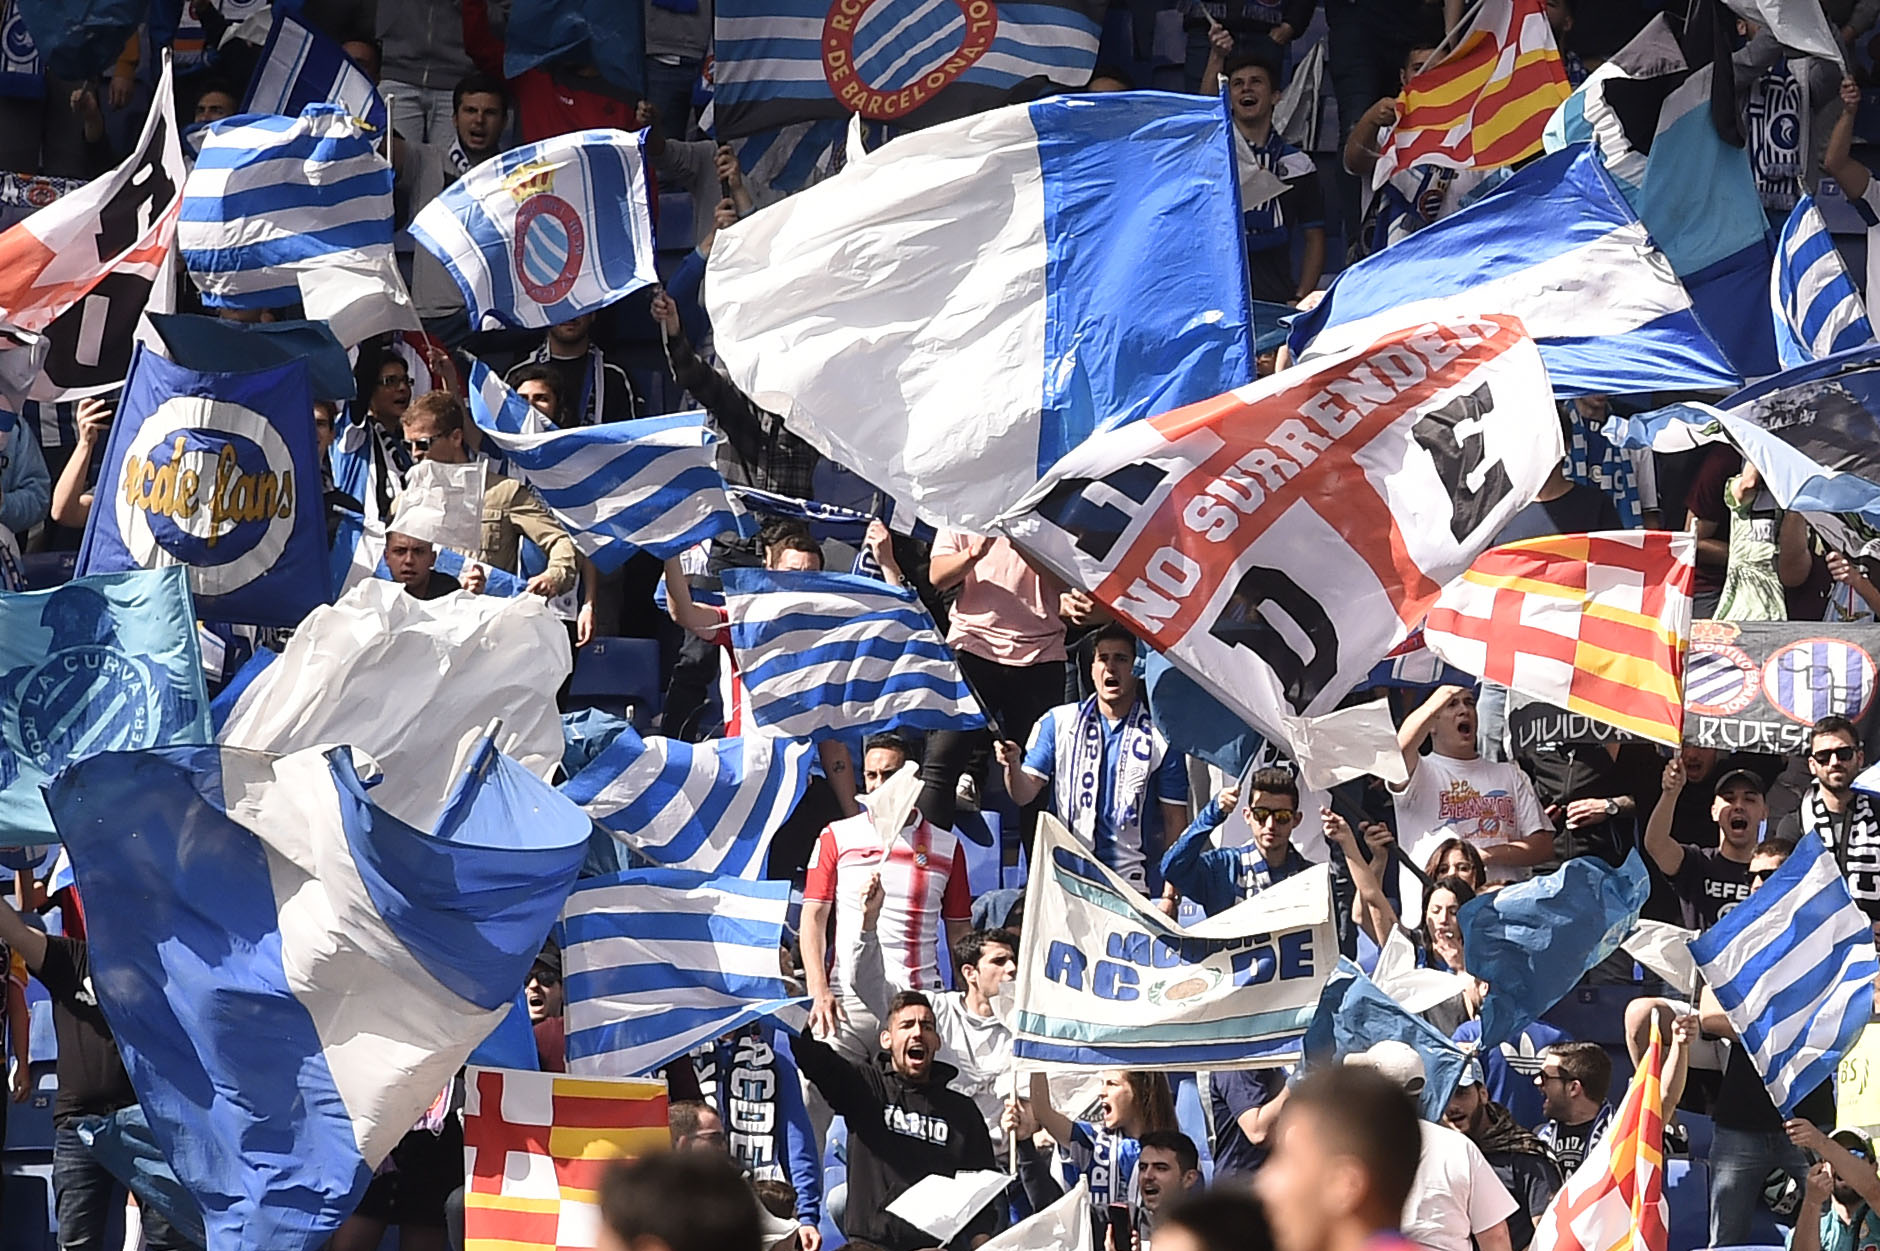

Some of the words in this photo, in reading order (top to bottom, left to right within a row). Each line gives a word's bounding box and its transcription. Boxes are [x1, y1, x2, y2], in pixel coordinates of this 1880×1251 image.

[826, 49, 848, 82] DE
[840, 43, 986, 115] BARCELONA
[206, 444, 293, 549] fans
[1112, 545, 1202, 634] NO
[28, 675, 56, 706] LA
[63, 653, 143, 698] CURVA
